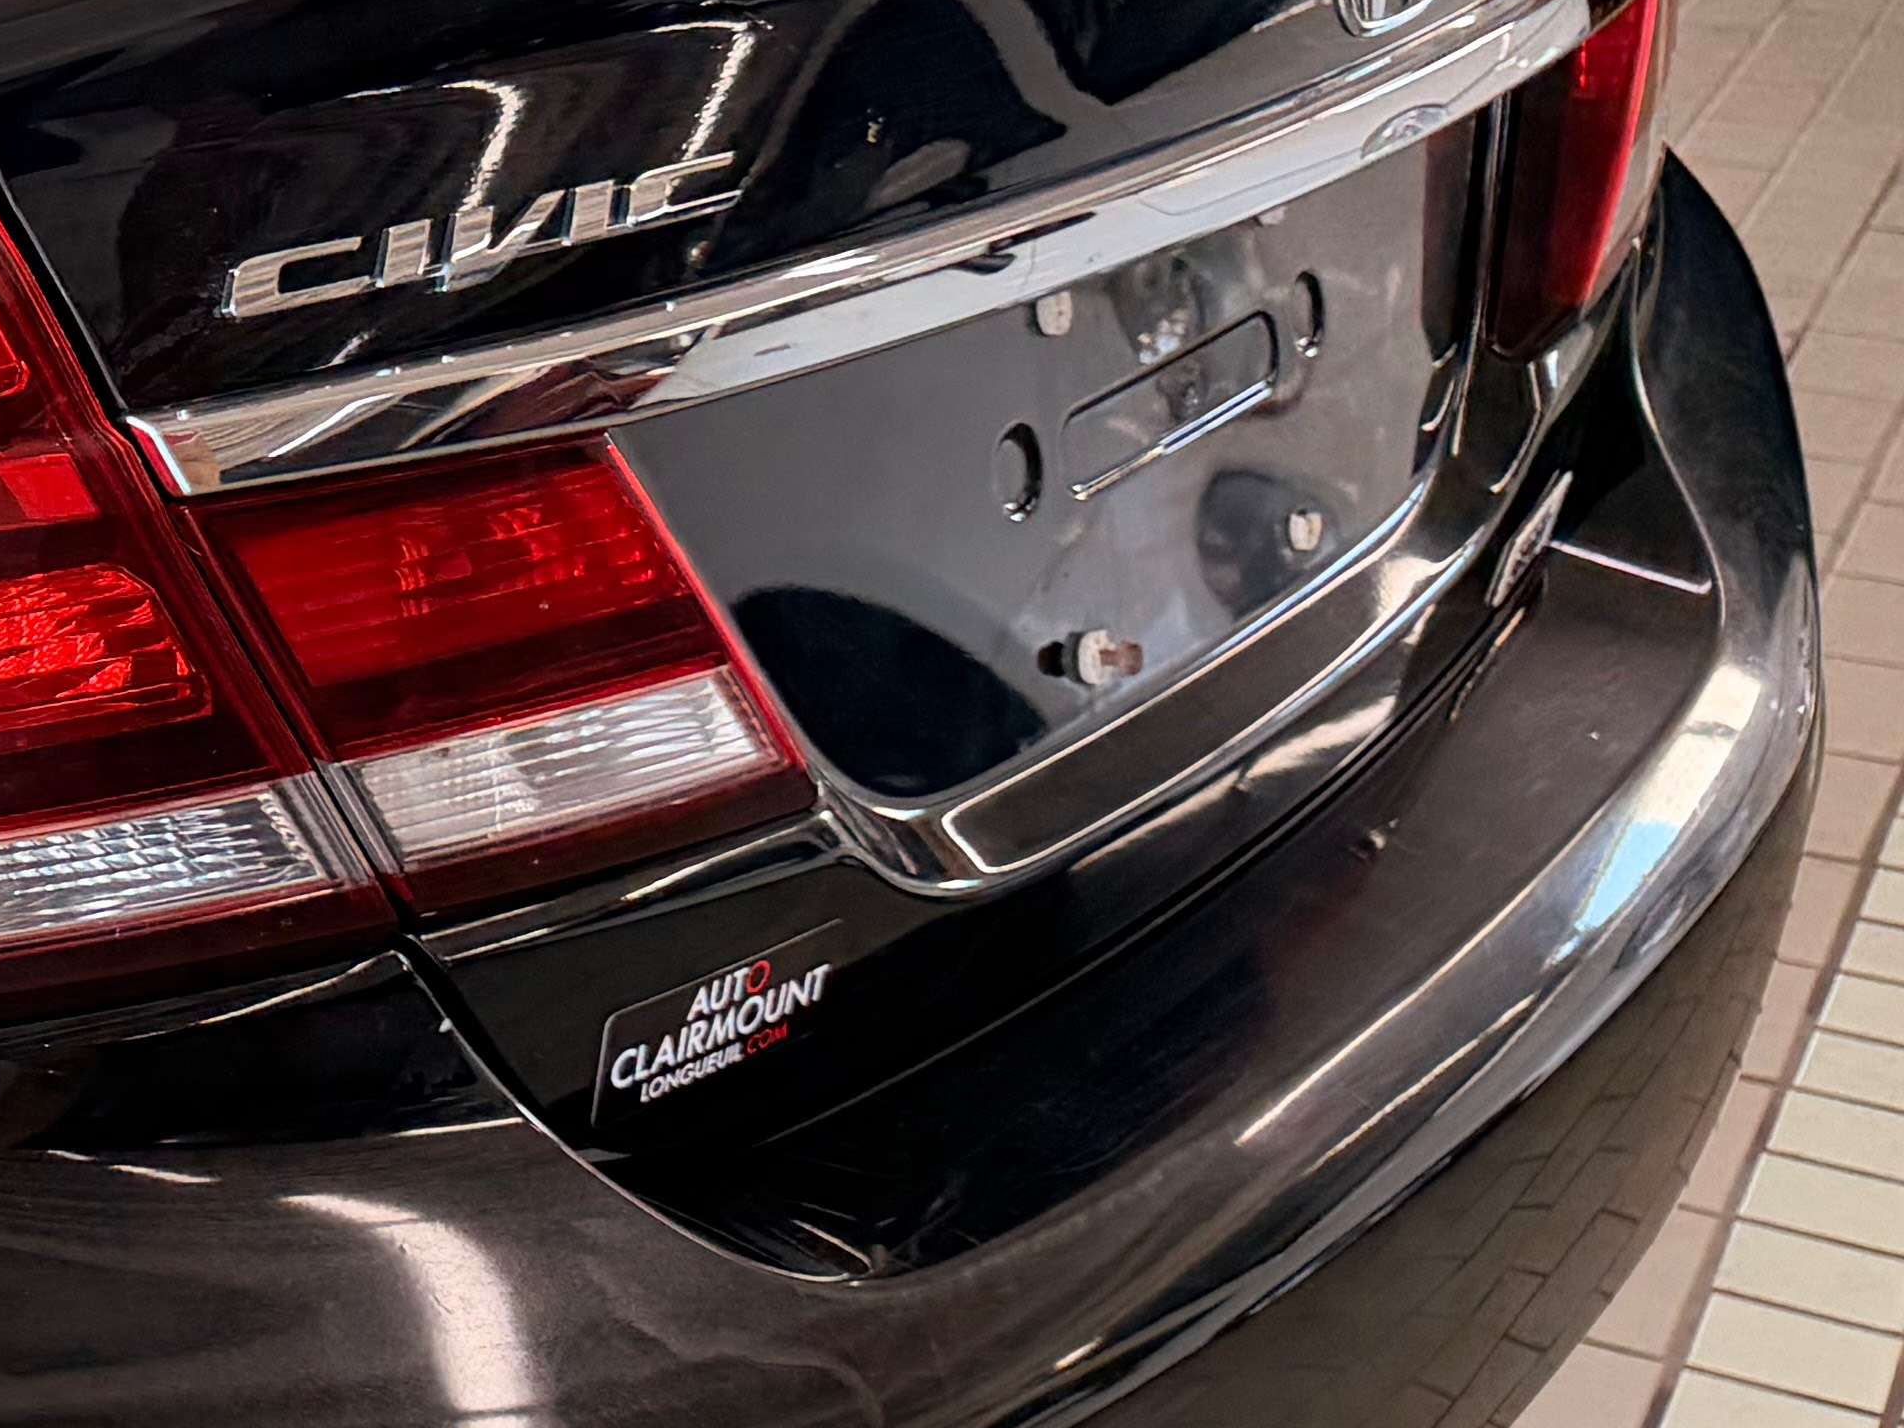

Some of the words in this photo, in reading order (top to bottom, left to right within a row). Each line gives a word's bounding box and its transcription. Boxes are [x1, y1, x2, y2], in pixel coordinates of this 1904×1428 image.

[221, 150, 745, 319] CIVIC
[610, 963, 832, 1090] CLAIRMOUNT
[687, 960, 772, 1021] AUTO
